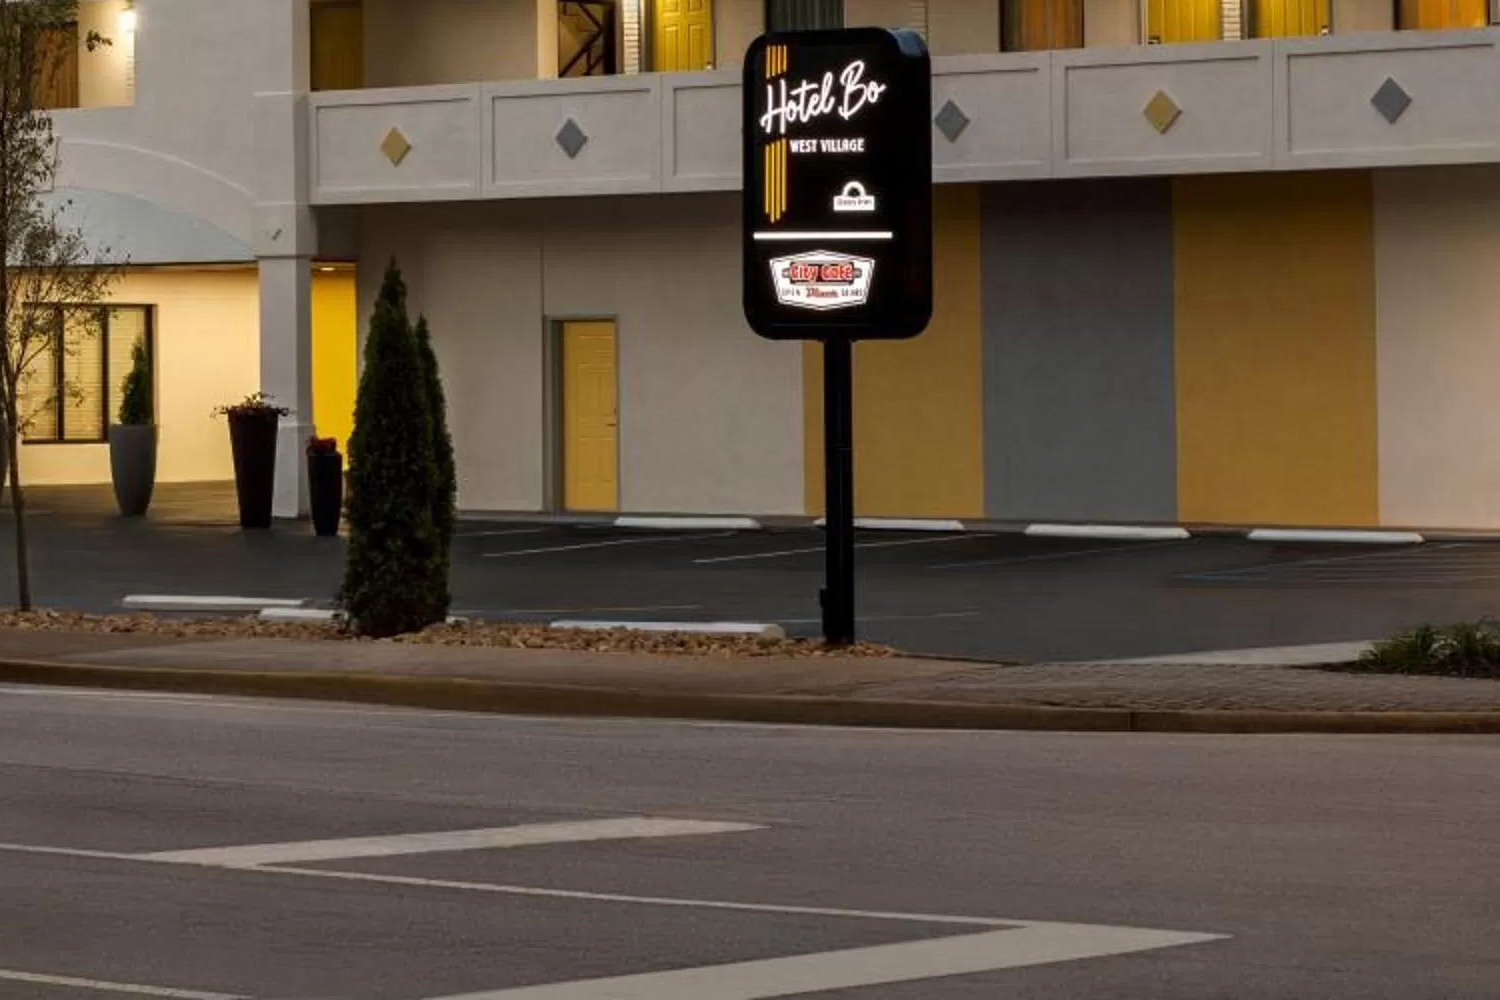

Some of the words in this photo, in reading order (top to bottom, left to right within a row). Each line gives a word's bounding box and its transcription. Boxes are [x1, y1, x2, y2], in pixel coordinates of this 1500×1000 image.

[759, 72, 835, 134] Hotel
[838, 60, 887, 120] Bo
[789, 138, 817, 153] WEST
[820, 138, 865, 153] VILLAGE
